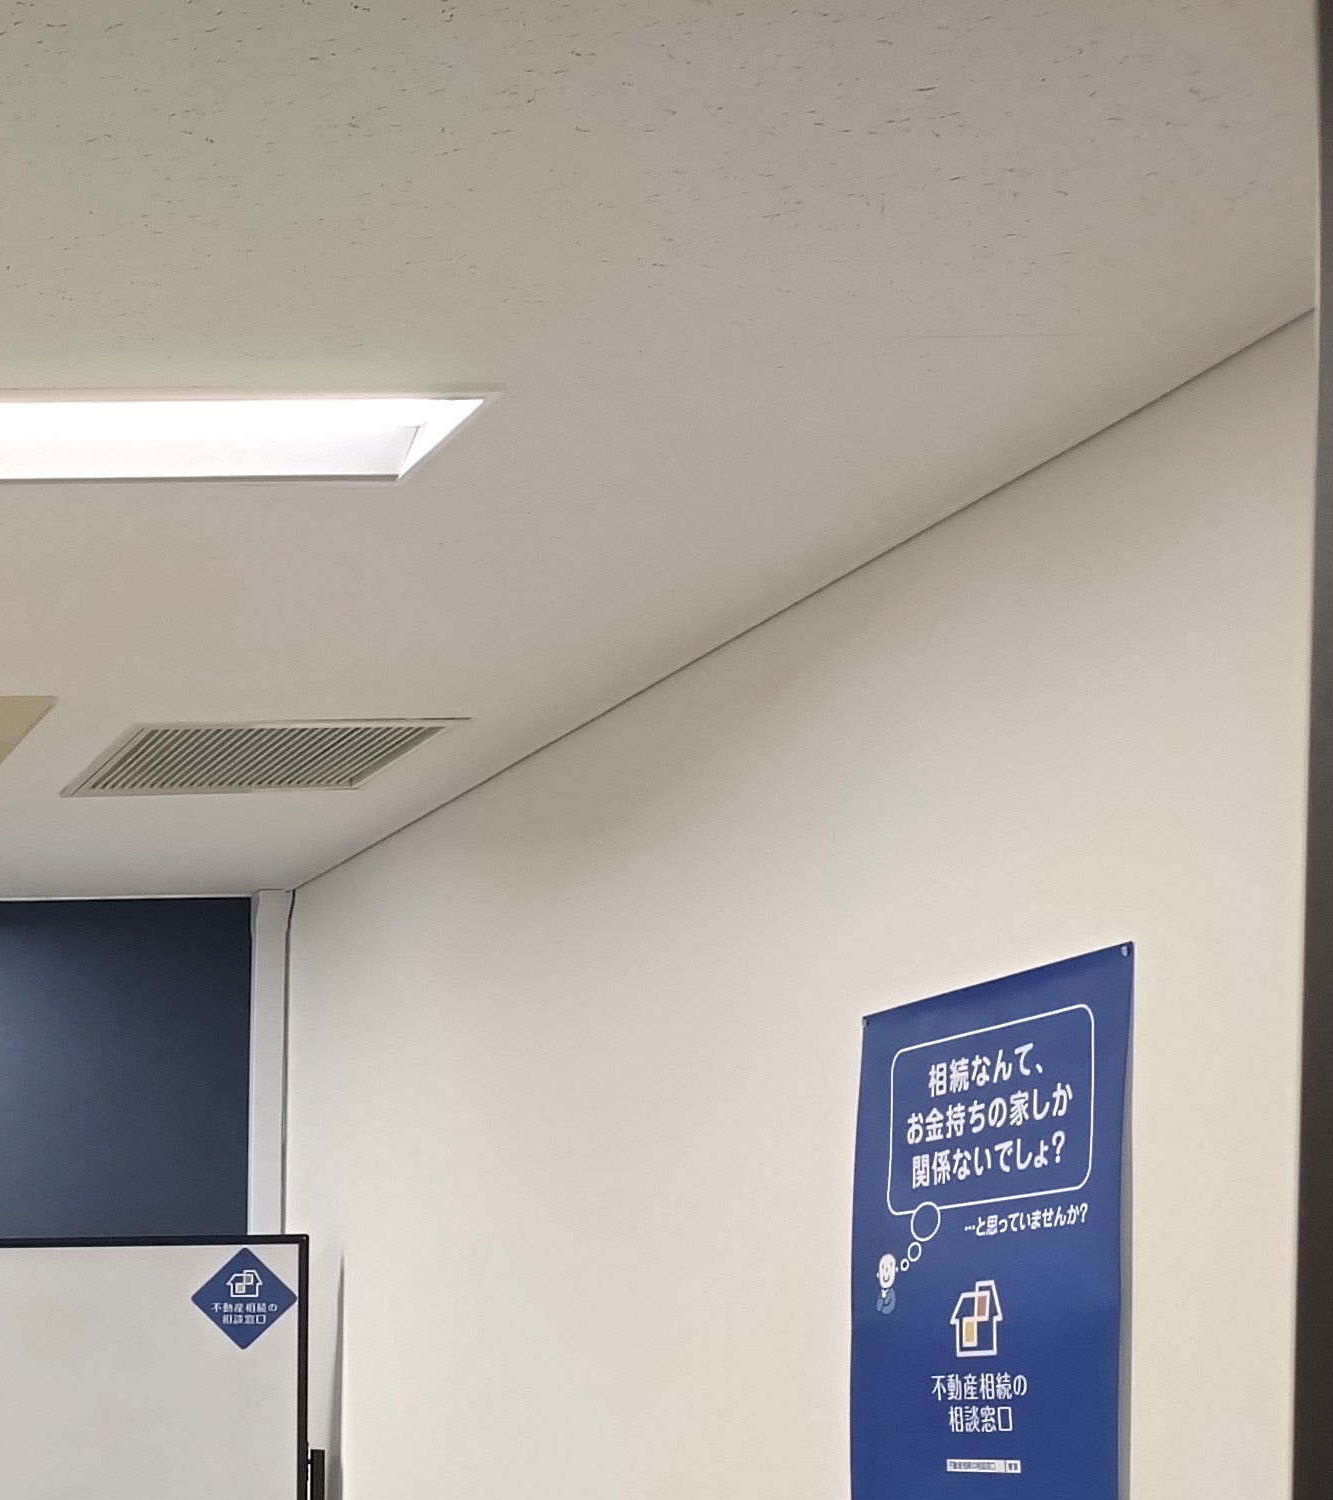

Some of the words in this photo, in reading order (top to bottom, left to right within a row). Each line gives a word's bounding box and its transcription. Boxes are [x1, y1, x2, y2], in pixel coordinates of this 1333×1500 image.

[928, 1043, 1043, 1097] 相続なんて、
[907, 1082, 1073, 1145] お金持ちの家しか
[211, 1303, 278, 1313] 不動産相続の
[223, 1314, 266, 1324] 相談窓口
[931, 1372, 1027, 1401] 不動産相続の
[949, 1405, 1012, 1432] 相談窓口
